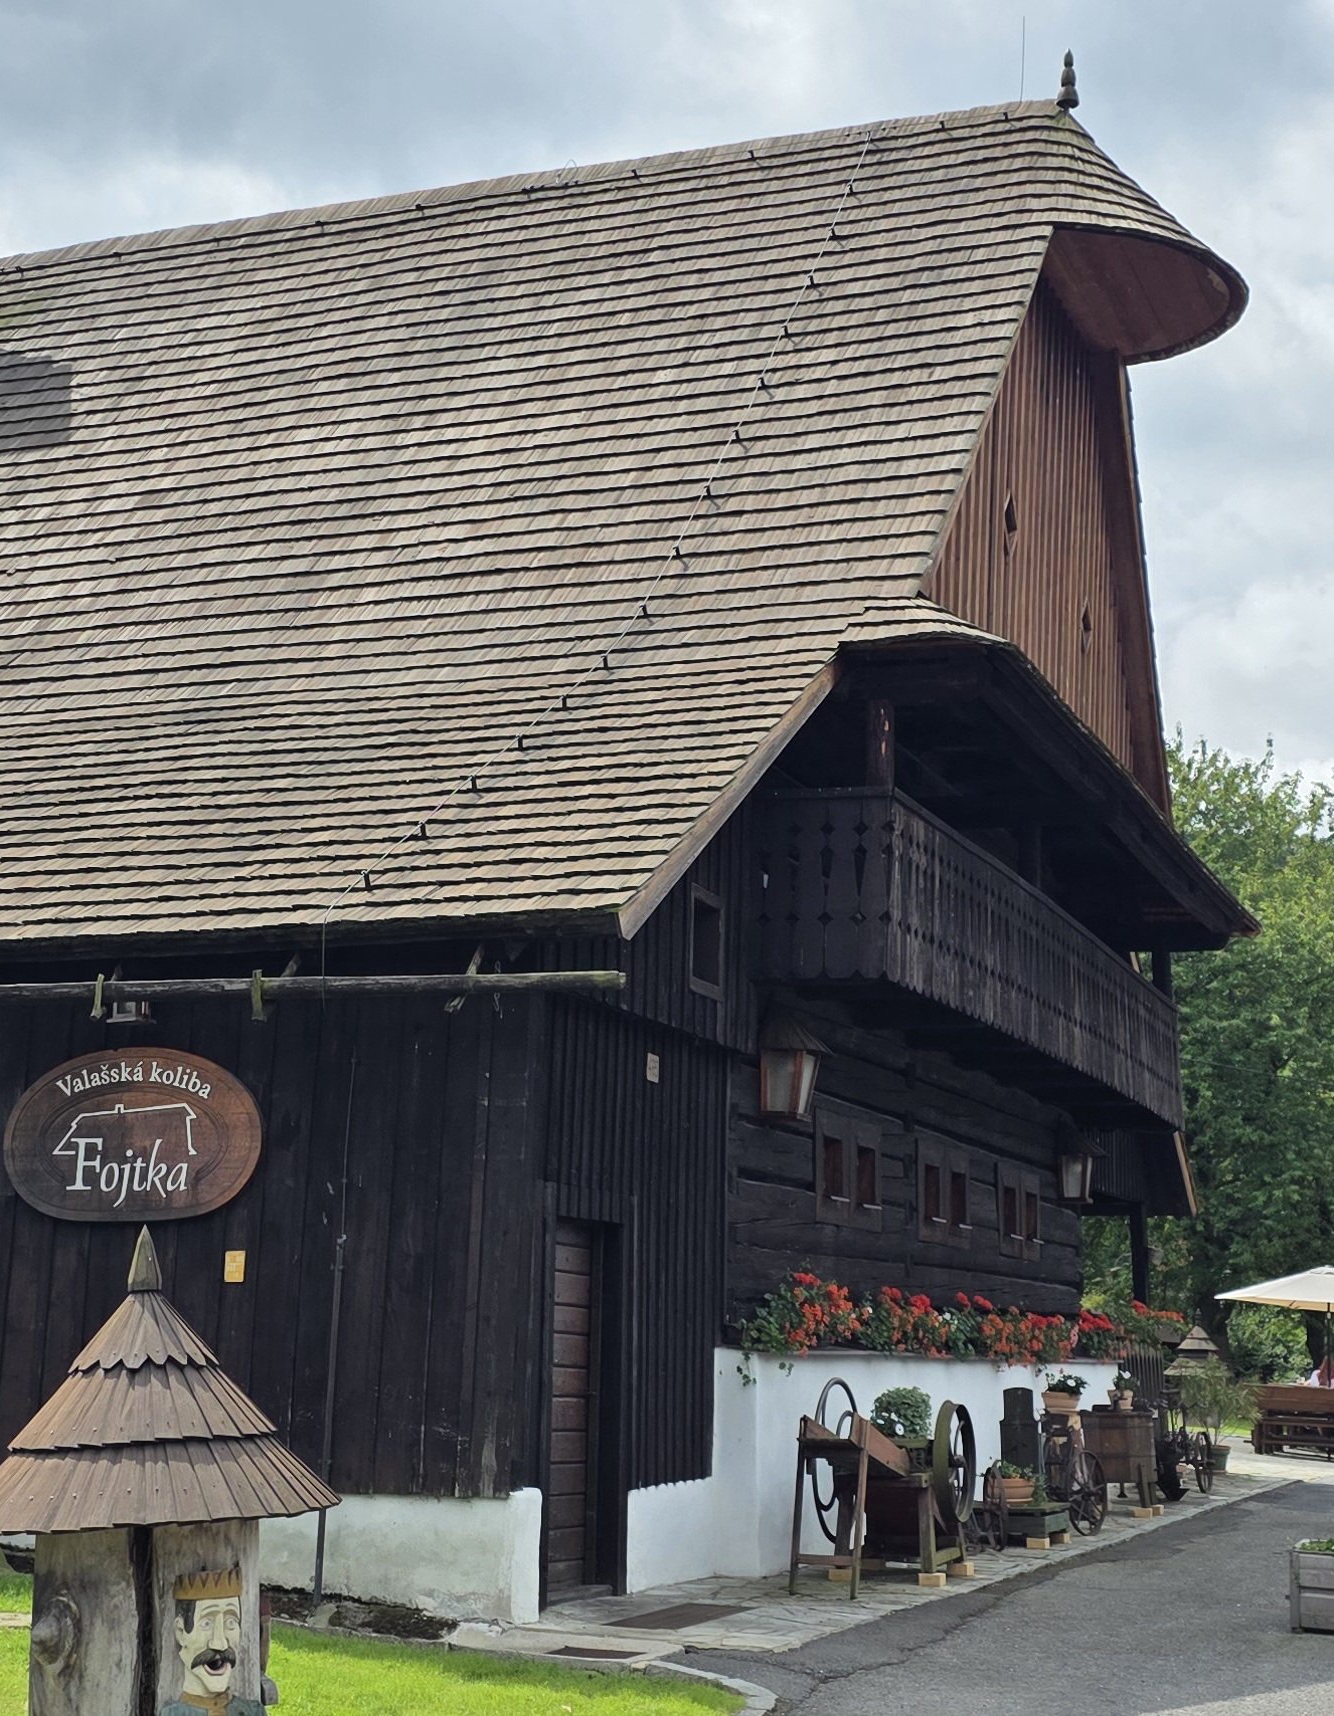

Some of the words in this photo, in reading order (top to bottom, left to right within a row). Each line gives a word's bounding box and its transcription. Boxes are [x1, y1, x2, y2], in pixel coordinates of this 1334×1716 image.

[55, 1060, 144, 1097] Valašská
[148, 1061, 212, 1099] koliba
[66, 1137, 189, 1208] Fojtka
